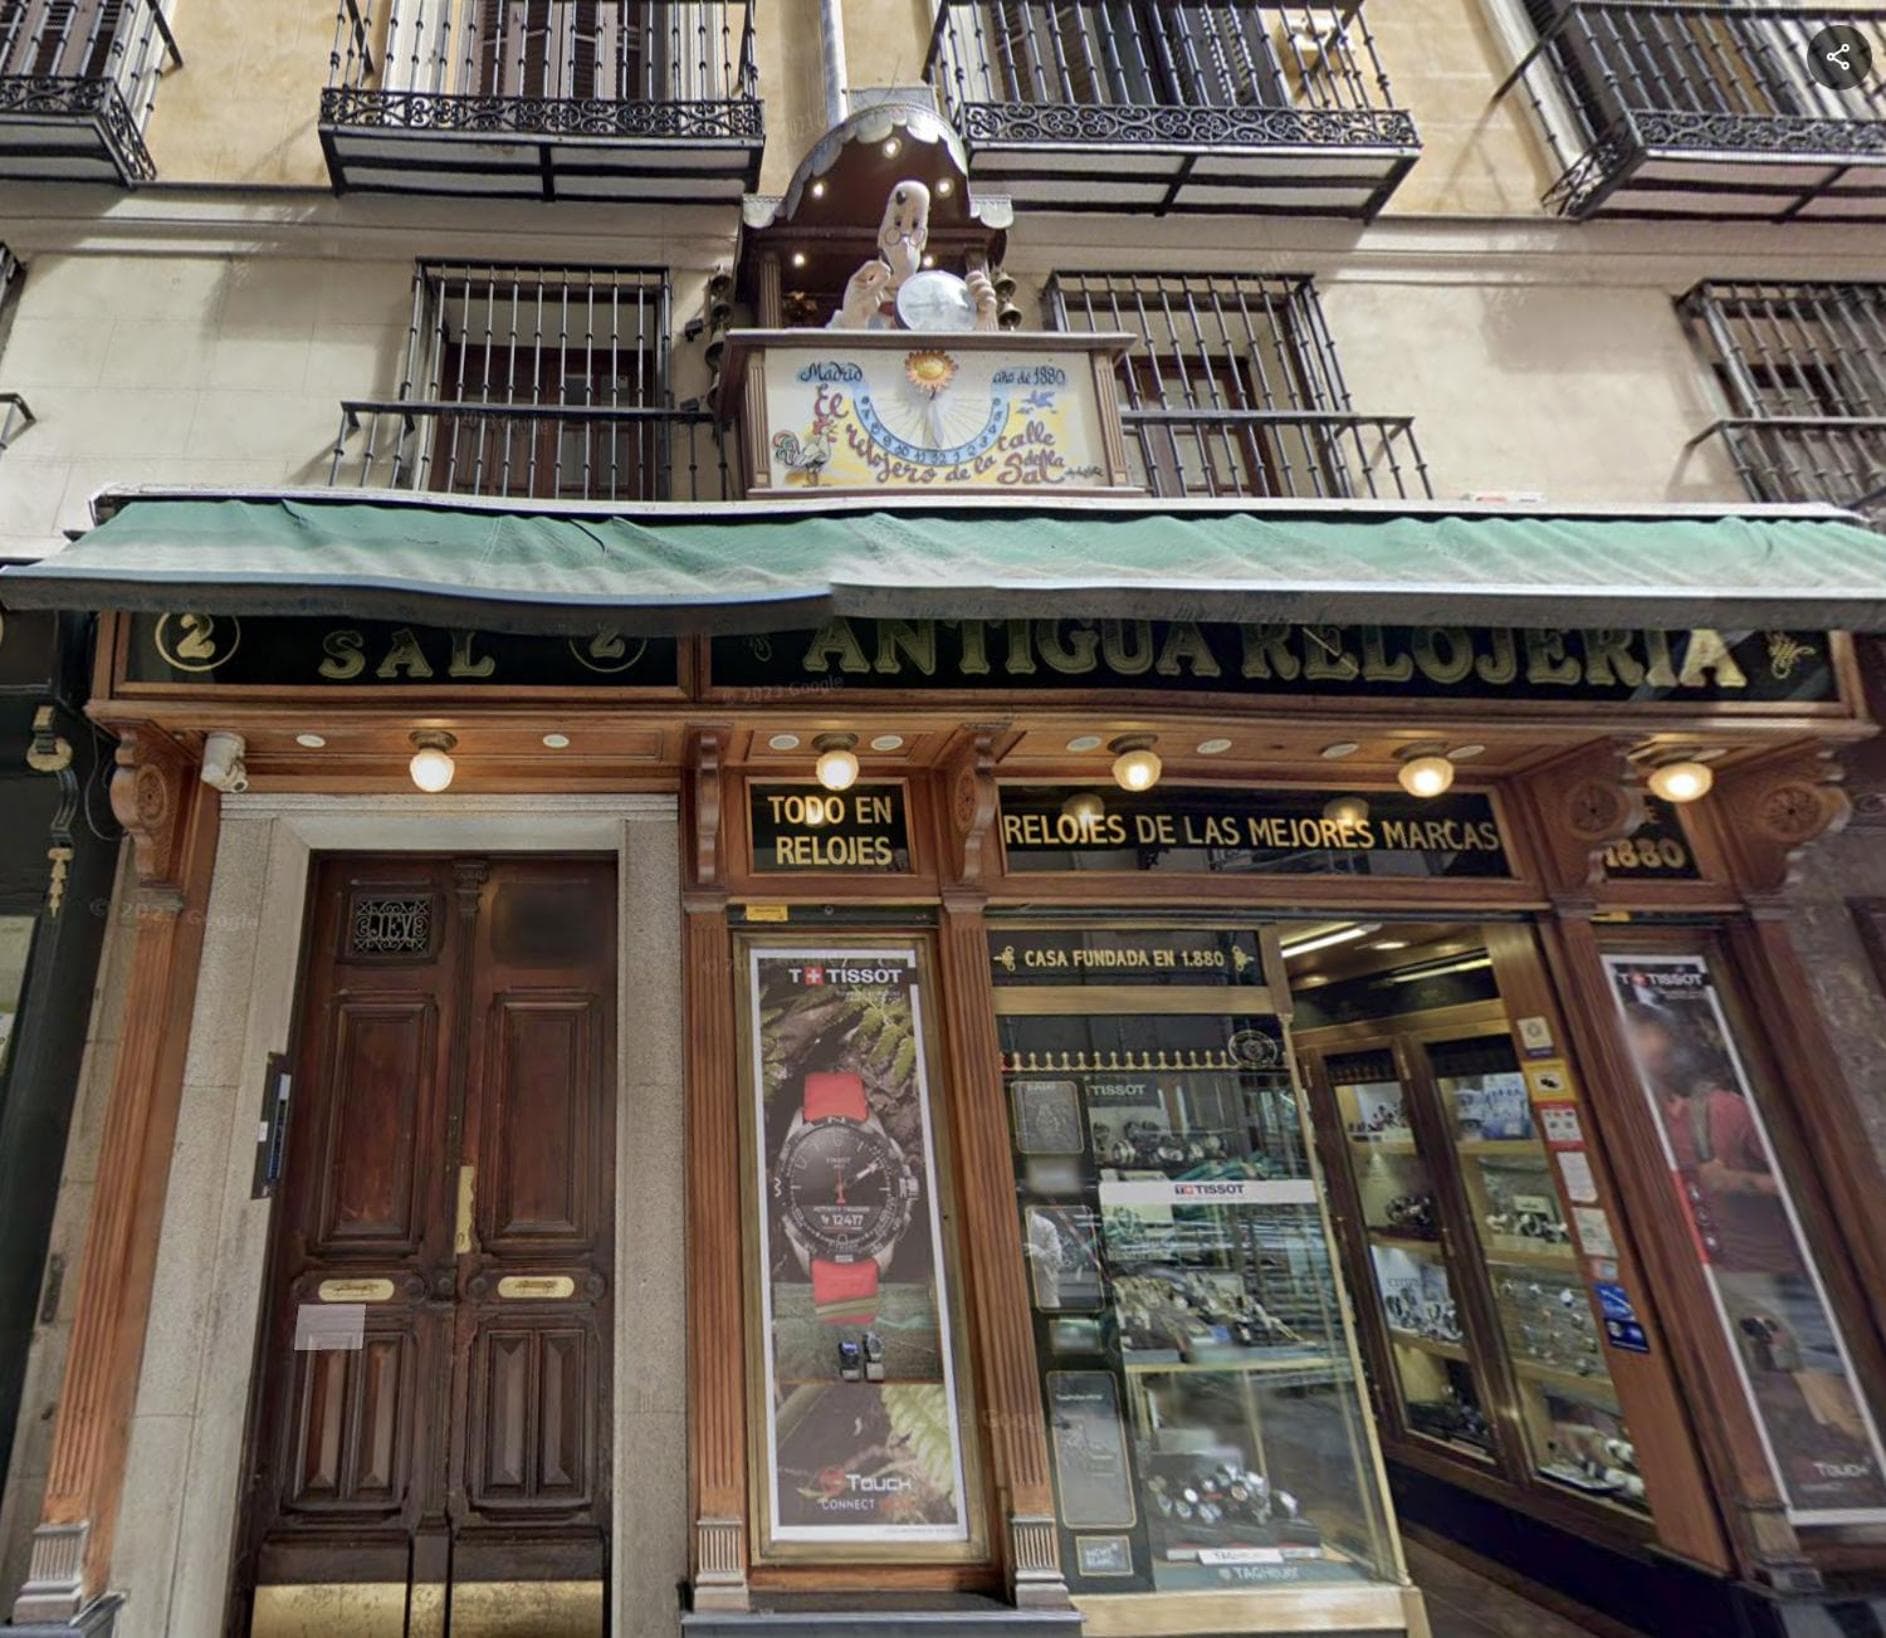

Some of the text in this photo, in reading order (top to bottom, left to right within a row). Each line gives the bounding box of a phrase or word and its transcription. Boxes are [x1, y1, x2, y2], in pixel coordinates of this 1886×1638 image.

[800, 361, 863, 381] Madrid
[814, 383, 849, 418] El
[998, 420, 1056, 451] calle
[846, 423, 998, 483] relojero de la
[177, 613, 216, 658] 2
[317, 625, 496, 680] SAL
[802, 615, 1222, 677] ANTIGUA
[767, 796, 893, 825] TODO EN
[1003, 814, 1500, 850] RELOJES DE LAS MEJORES MARCAS
[776, 836, 893, 866] RELOJES
[1604, 838, 1686, 869] 1880
[1024, 950, 1225, 967] CASA FUNDADA EN 1.880
[825, 968, 903, 984] TISSOT
[1193, 1183, 1245, 1195] TISSOT
[821, 1498, 875, 1511] CONNECT
